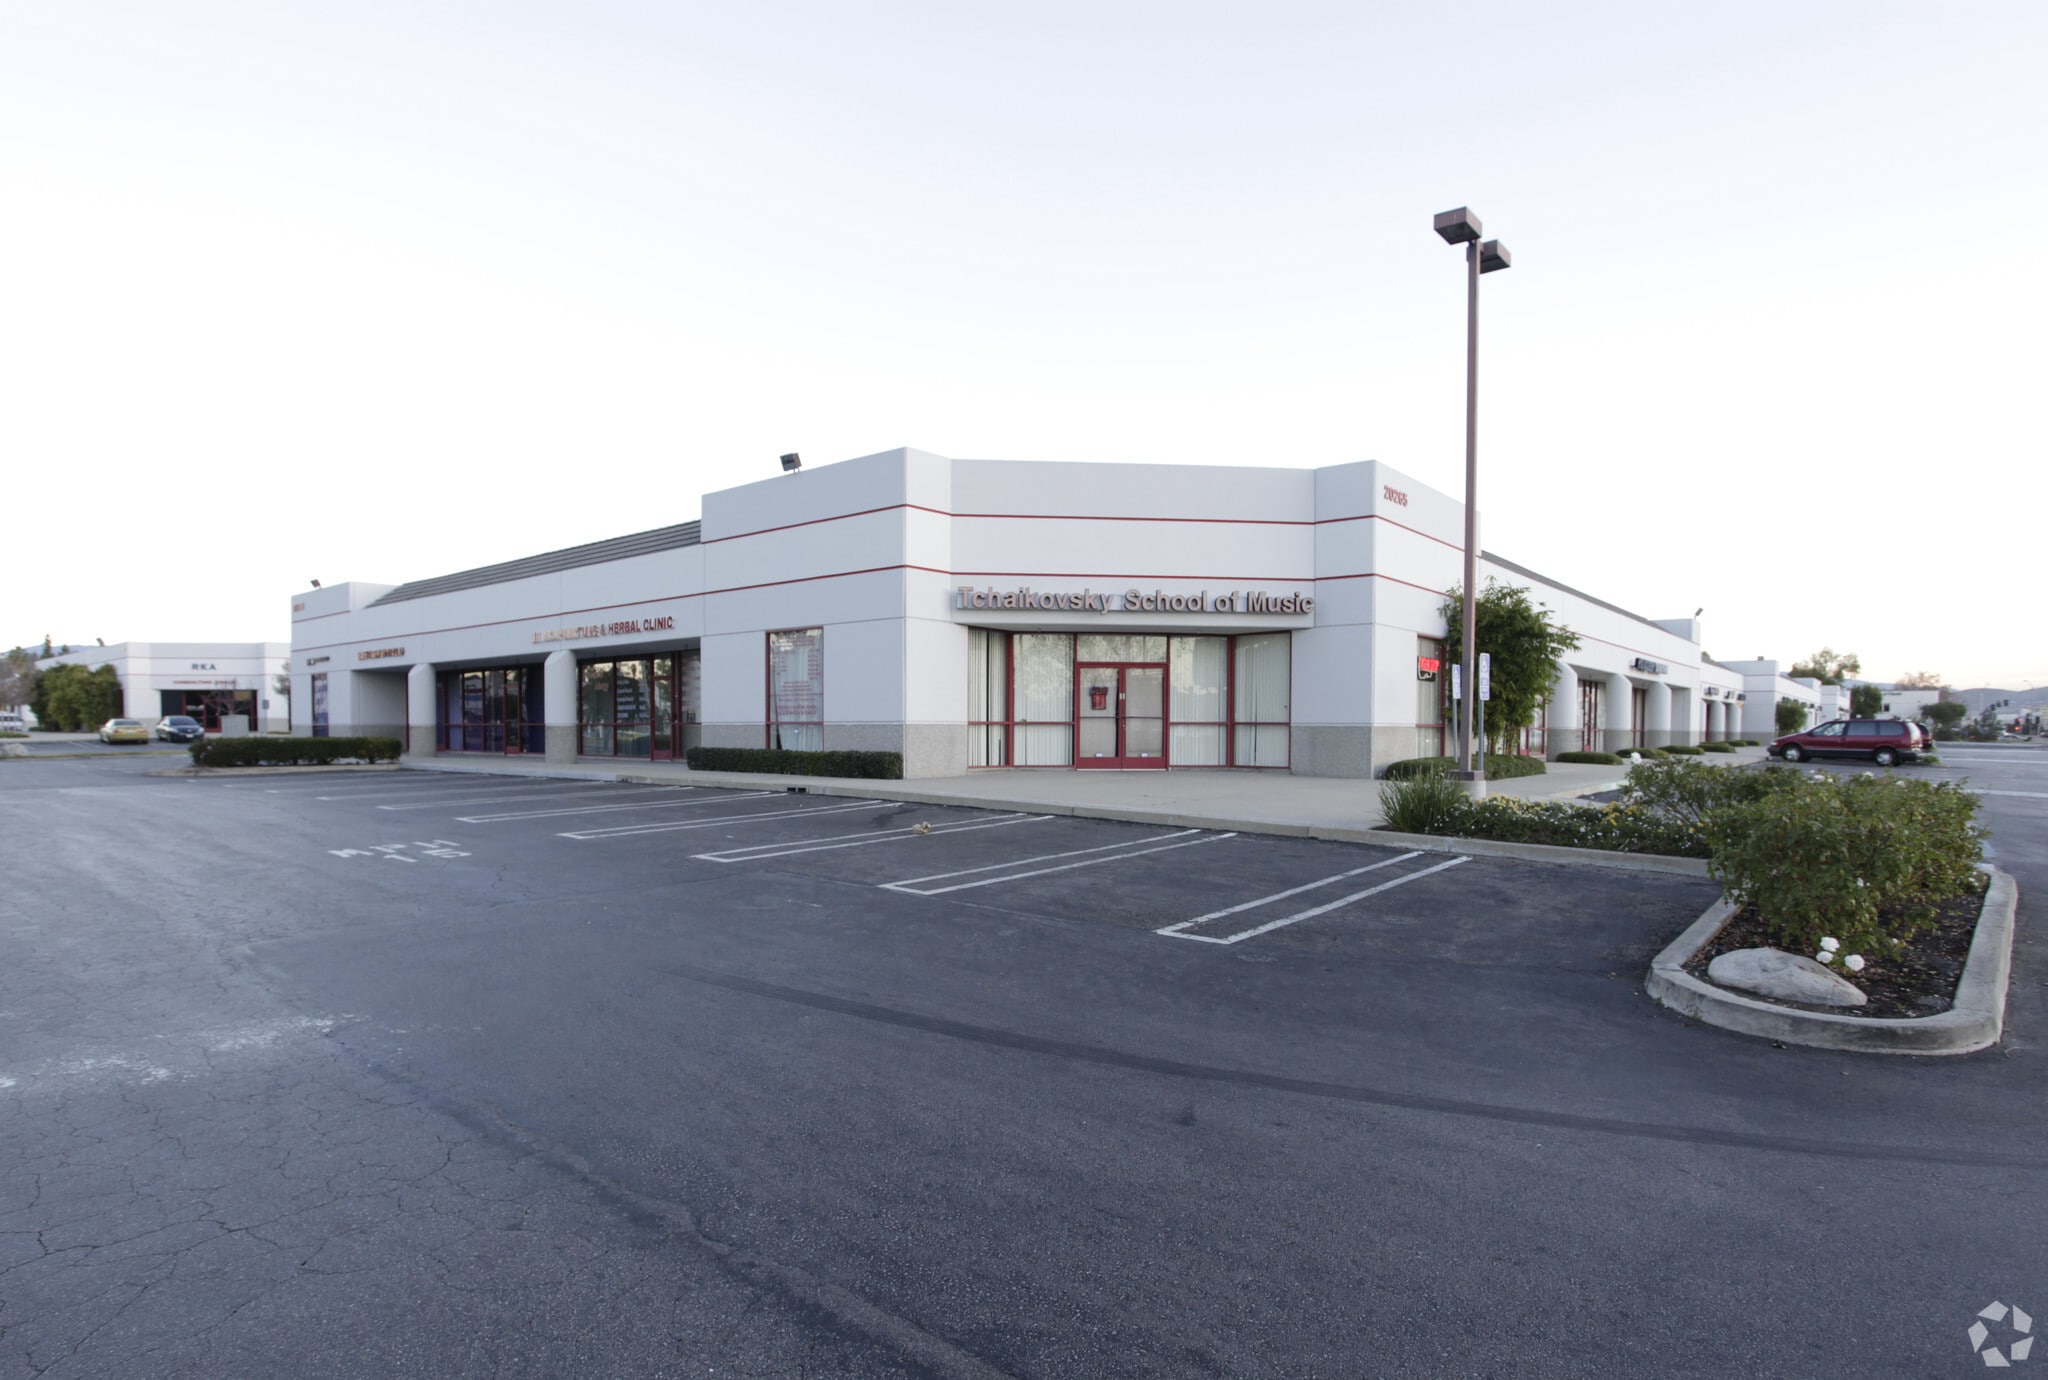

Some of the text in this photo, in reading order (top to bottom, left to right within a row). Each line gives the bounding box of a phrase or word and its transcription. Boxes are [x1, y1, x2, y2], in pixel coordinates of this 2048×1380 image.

[957, 586, 1315, 615] Tchaikovsky School of Music
[608, 620, 641, 635] HERBAL
[643, 615, 674, 631] CLINIC
[191, 663, 217, 671] RKA
[328, 839, 461, 858] MPH
